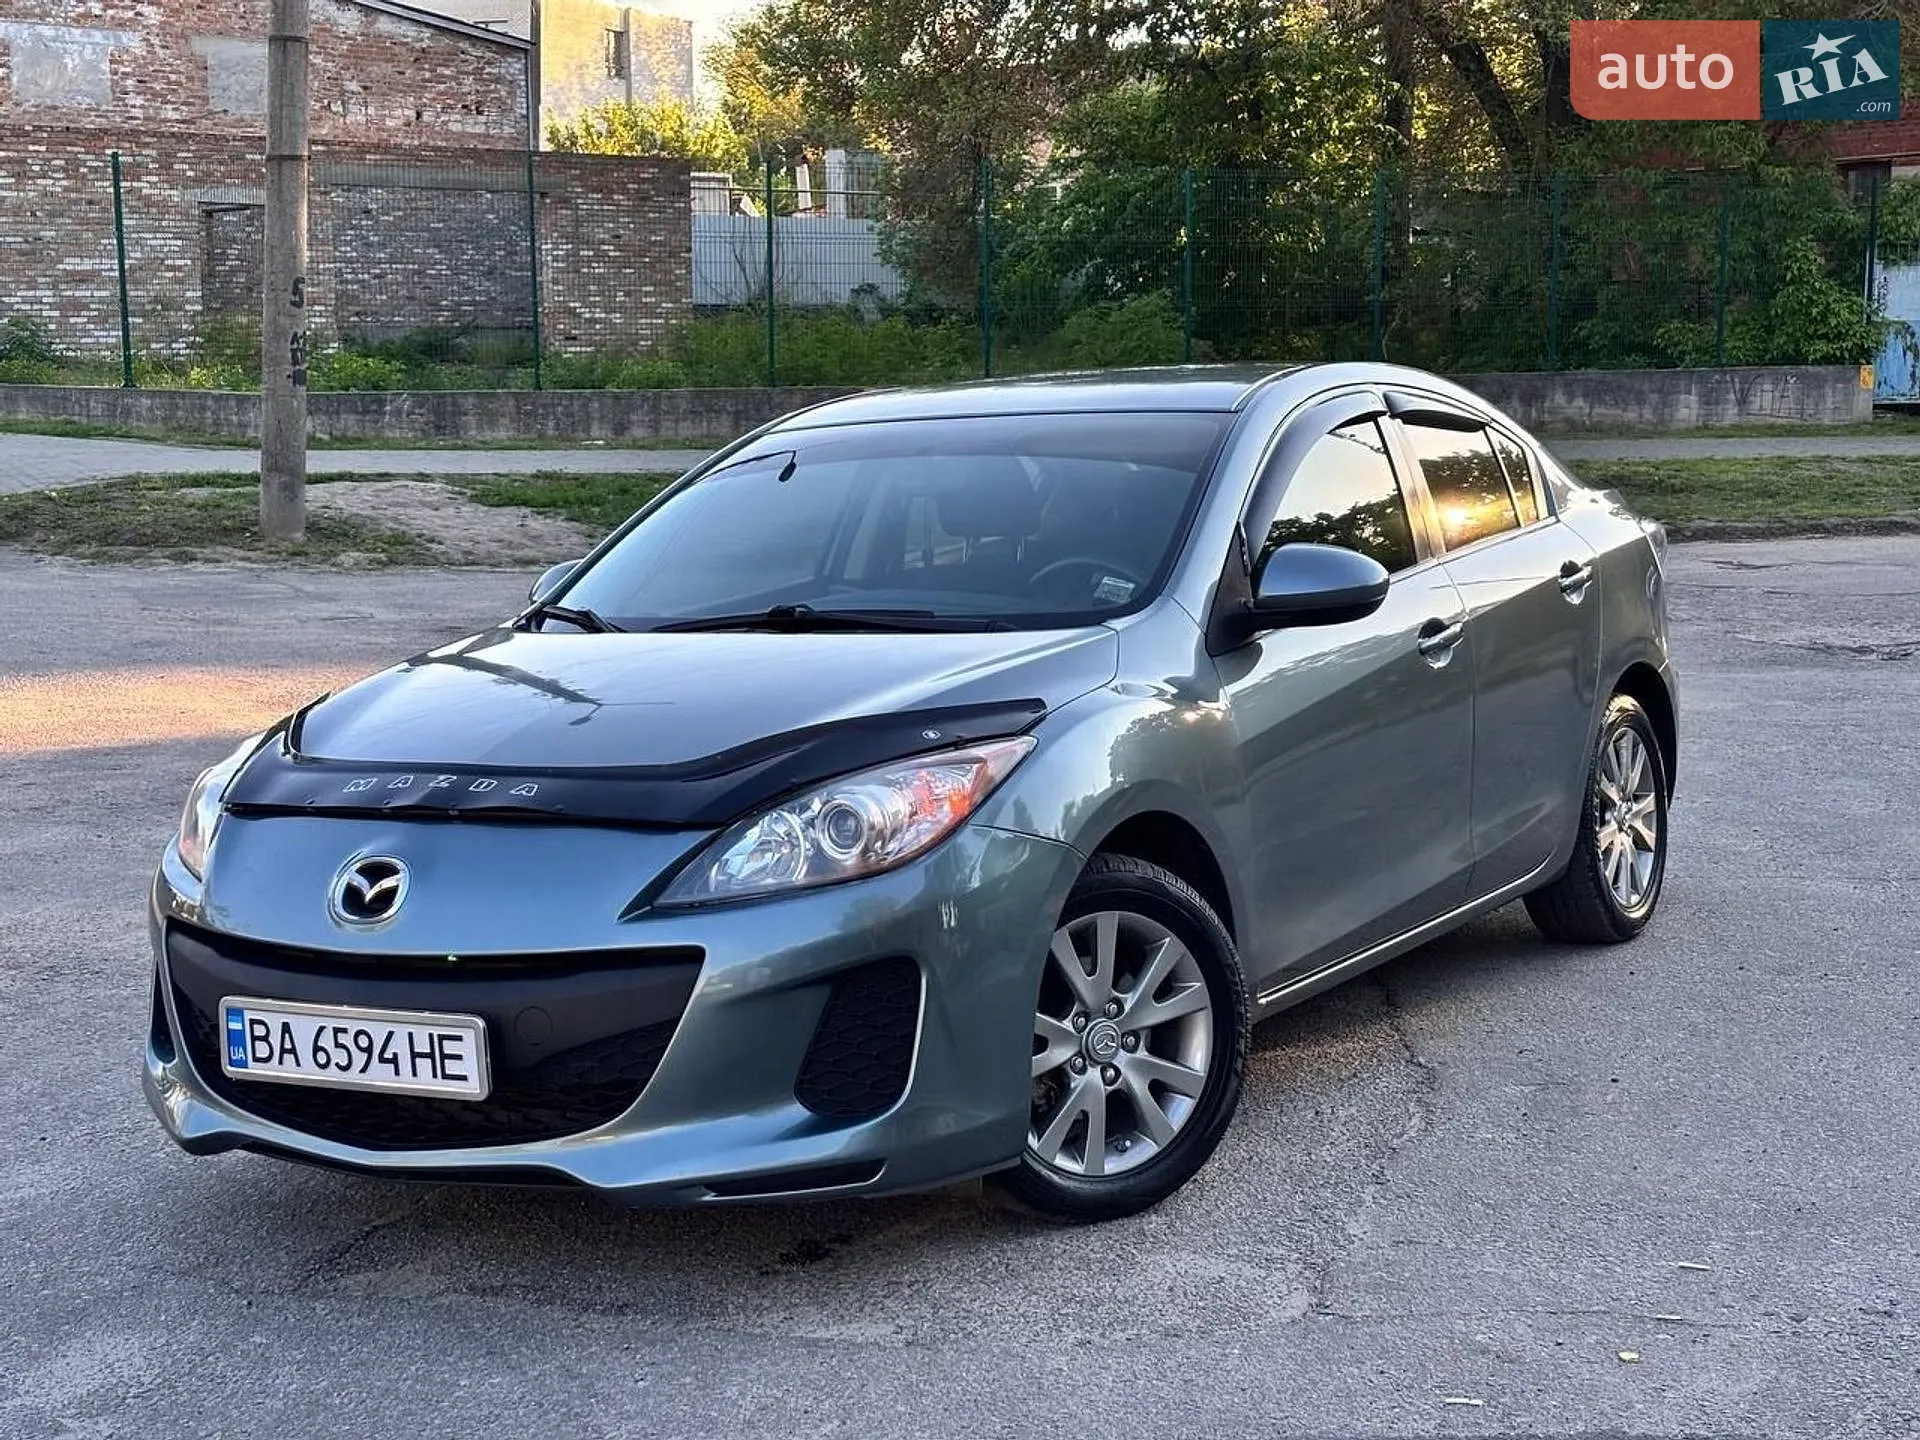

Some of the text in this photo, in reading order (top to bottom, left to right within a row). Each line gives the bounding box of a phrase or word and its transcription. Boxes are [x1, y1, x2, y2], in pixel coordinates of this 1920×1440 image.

[342, 775, 539, 797] MAZDA
[230, 1046, 245, 1060] UA
[249, 1018, 300, 1067] BA
